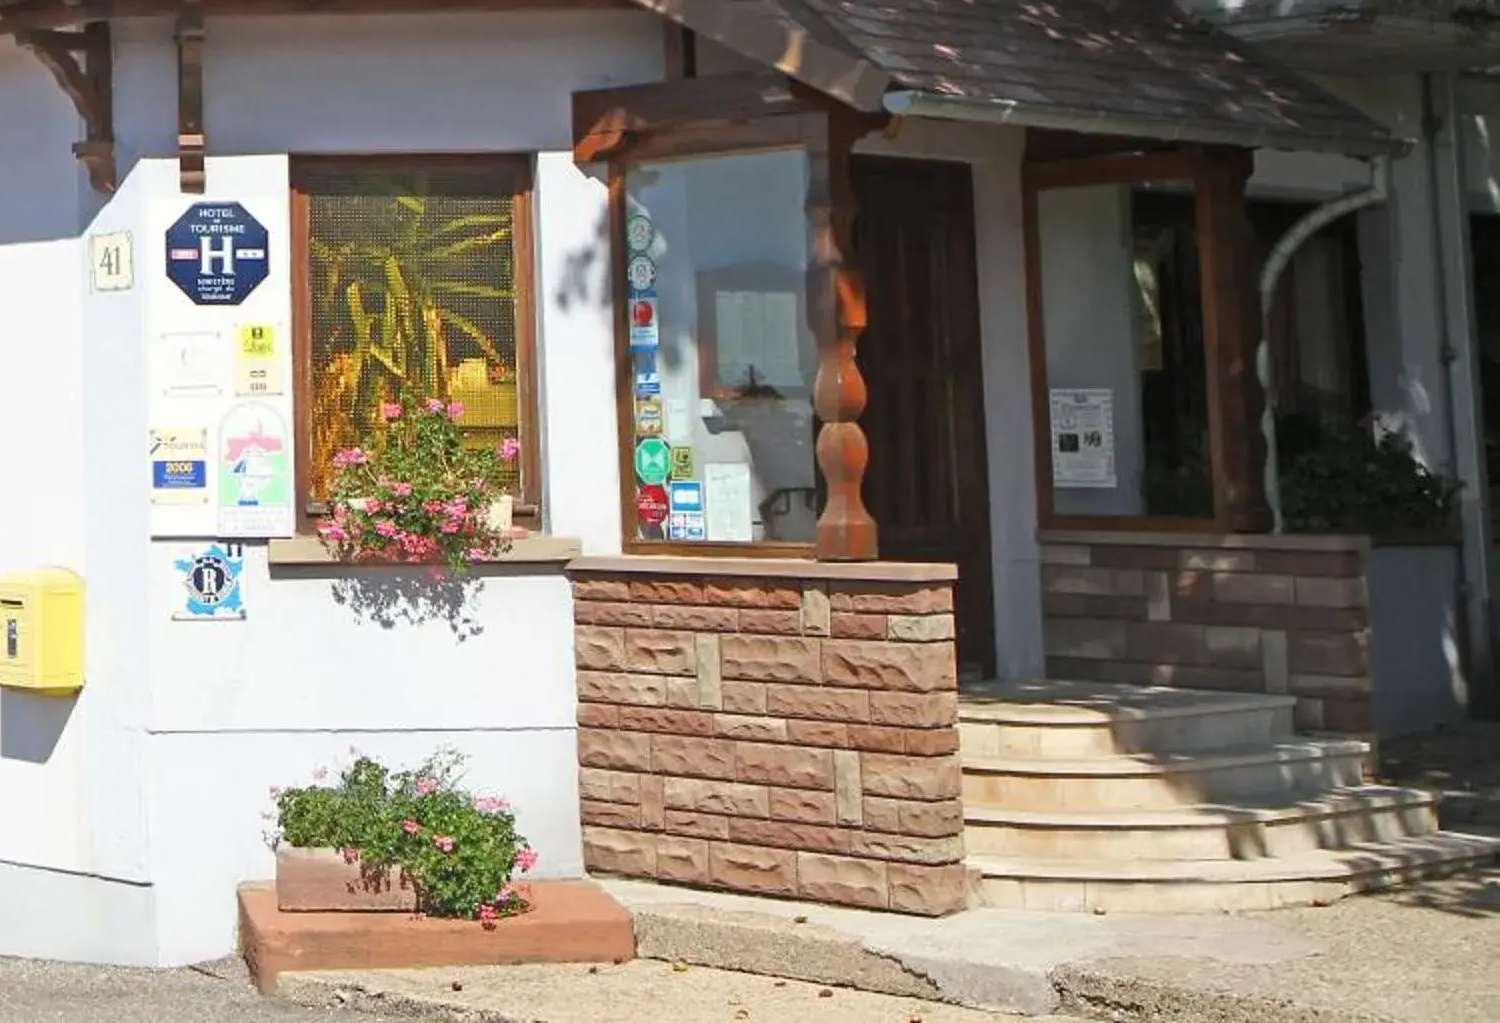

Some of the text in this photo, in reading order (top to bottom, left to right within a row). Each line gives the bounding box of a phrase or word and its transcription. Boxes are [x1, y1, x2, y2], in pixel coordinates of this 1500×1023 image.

[190, 224, 245, 234] TOURISME
[100, 246, 121, 276] 41
[200, 236, 236, 276] H
